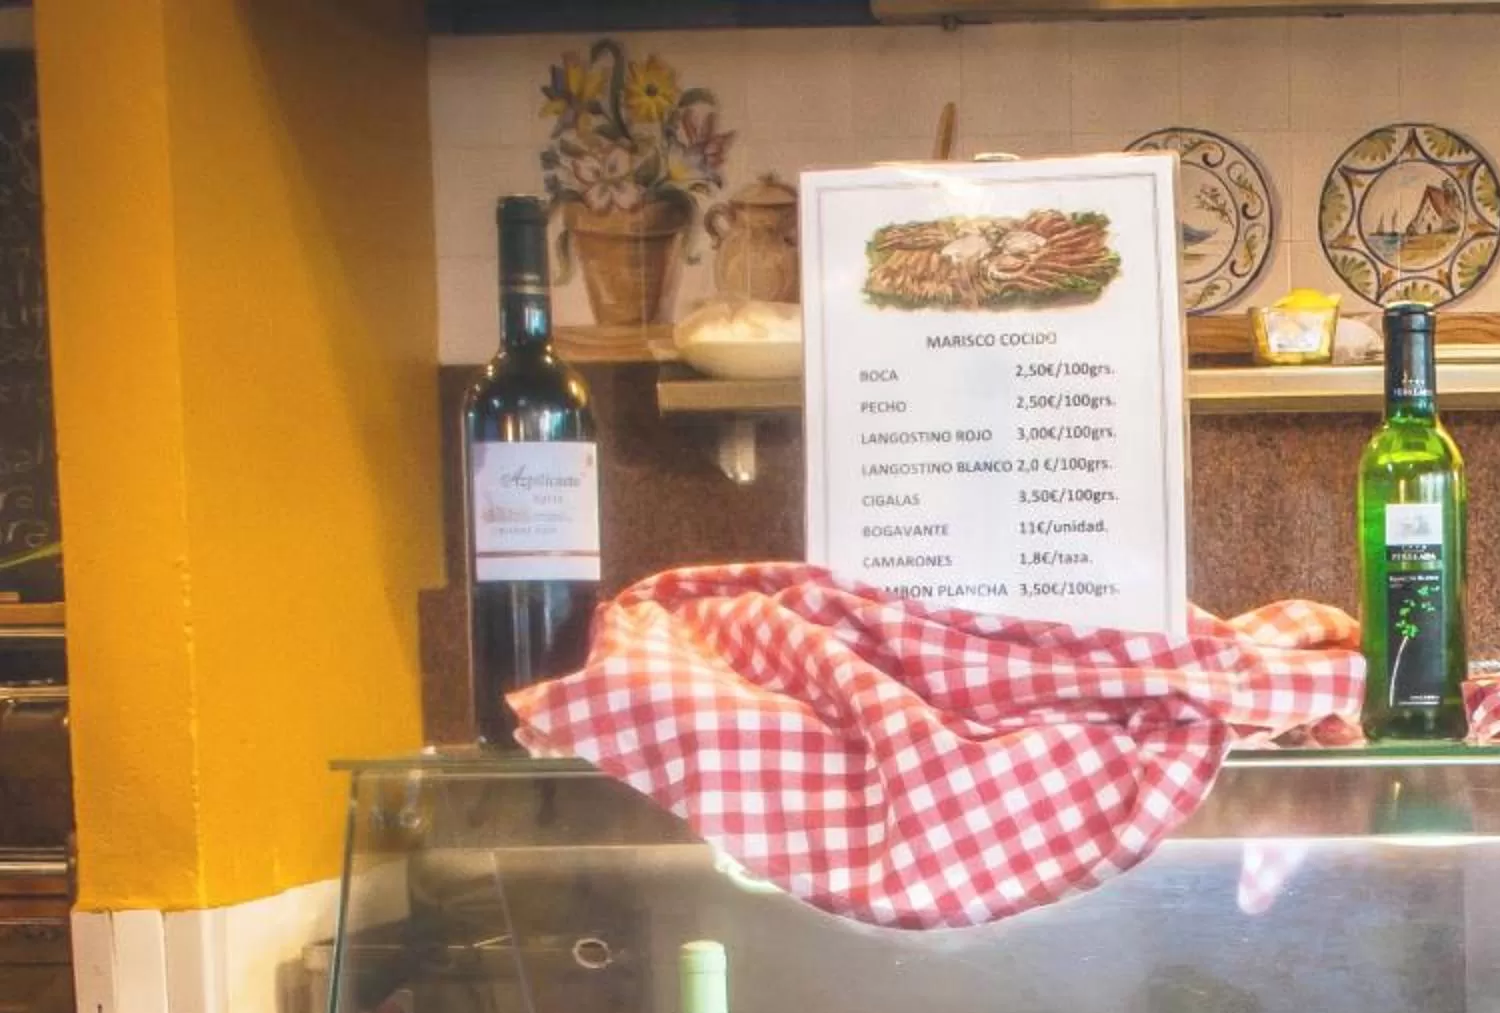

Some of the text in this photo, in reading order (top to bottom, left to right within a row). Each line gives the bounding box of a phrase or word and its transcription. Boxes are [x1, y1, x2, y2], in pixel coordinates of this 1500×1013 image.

[926, 332, 1058, 349] MARISCO COCIDO
[859, 362, 1116, 382] BOCA 2,50€/100grs.
[860, 394, 1117, 413] PECHO 2,50€/100grs.
[861, 426, 1117, 445] LANGOSTINO ROJO 3,00€/100grs.
[861, 461, 953, 476] LANGOSTINO
[956, 459, 1013, 473] BLANCO
[862, 488, 1119, 507] CIGALAS 3,50€/100grs.
[863, 523, 950, 537] BOGAVANTE
[863, 555, 953, 568] CAMARONES
[937, 583, 1009, 598] PLANCHA
[1019, 581, 1121, 597] 3,50€/100grs.
